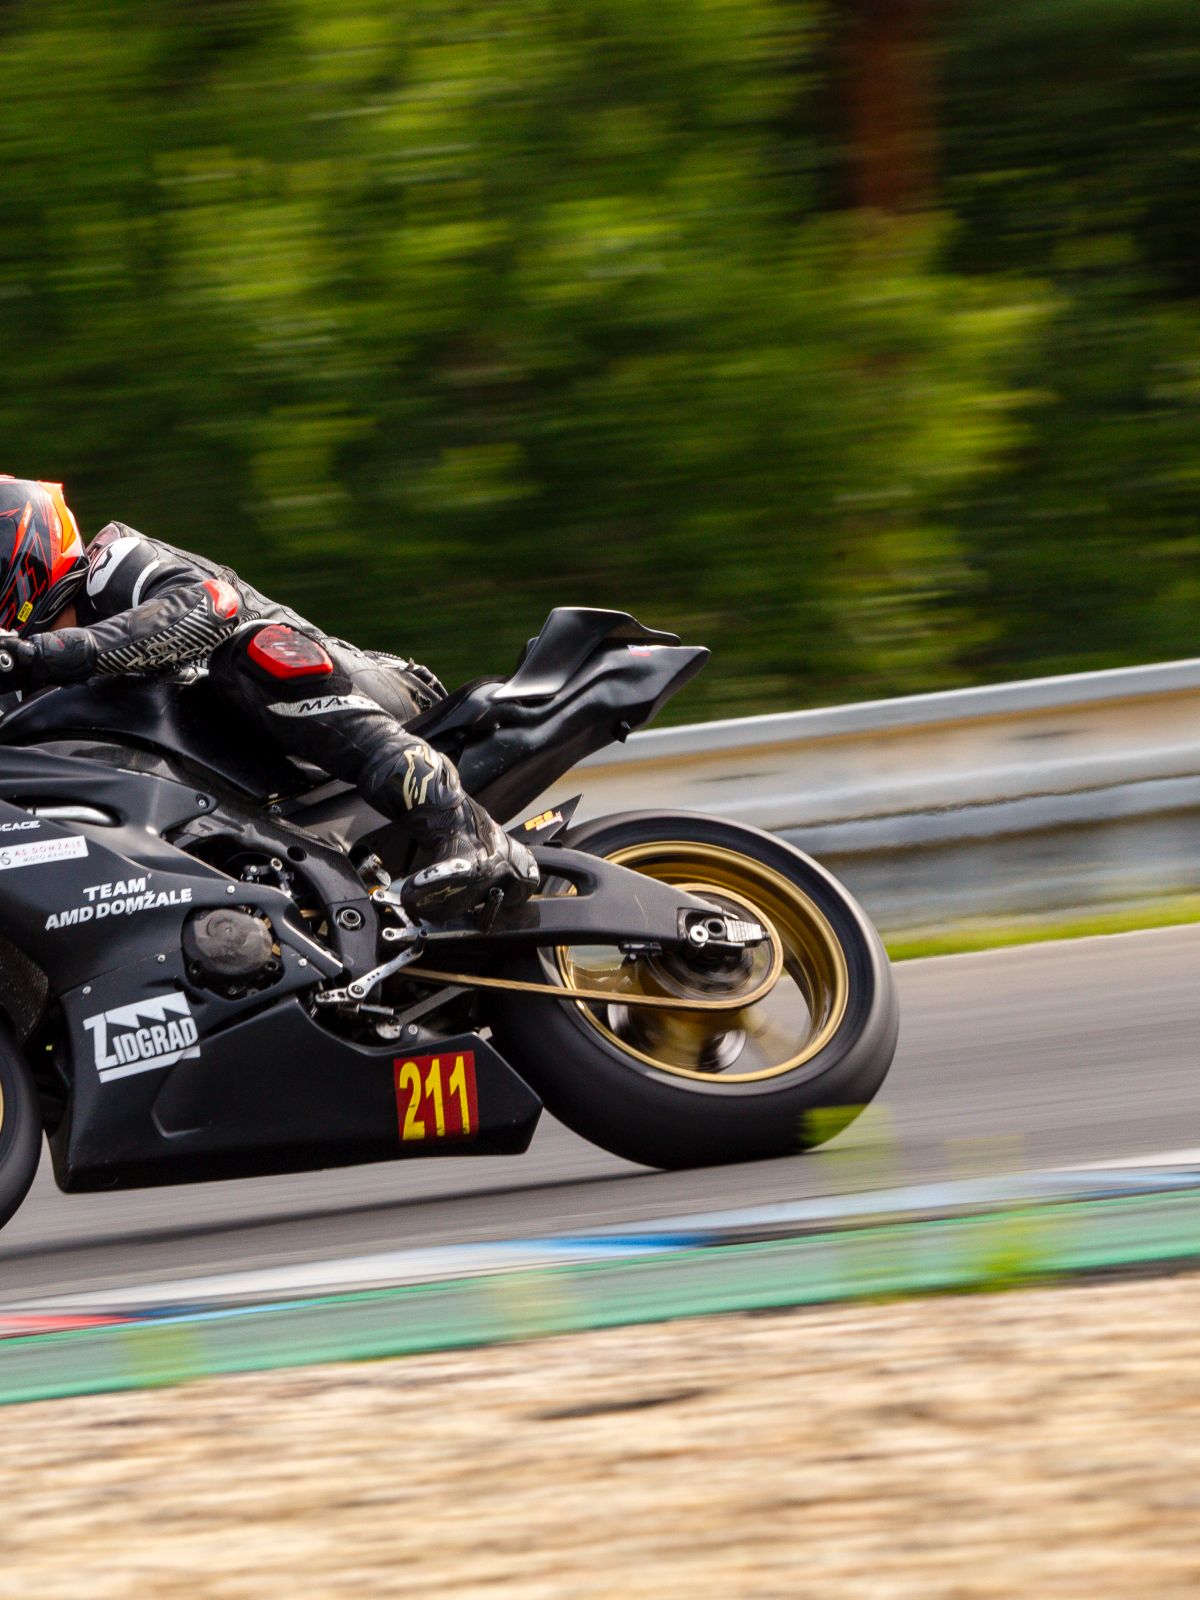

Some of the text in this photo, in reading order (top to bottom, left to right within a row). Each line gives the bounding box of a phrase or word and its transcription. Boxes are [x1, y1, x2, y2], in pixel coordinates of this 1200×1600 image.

[44, 888, 193, 931] AMD DOMŽALE
[83, 877, 146, 902] TEAM
[399, 1056, 470, 1140] 211
